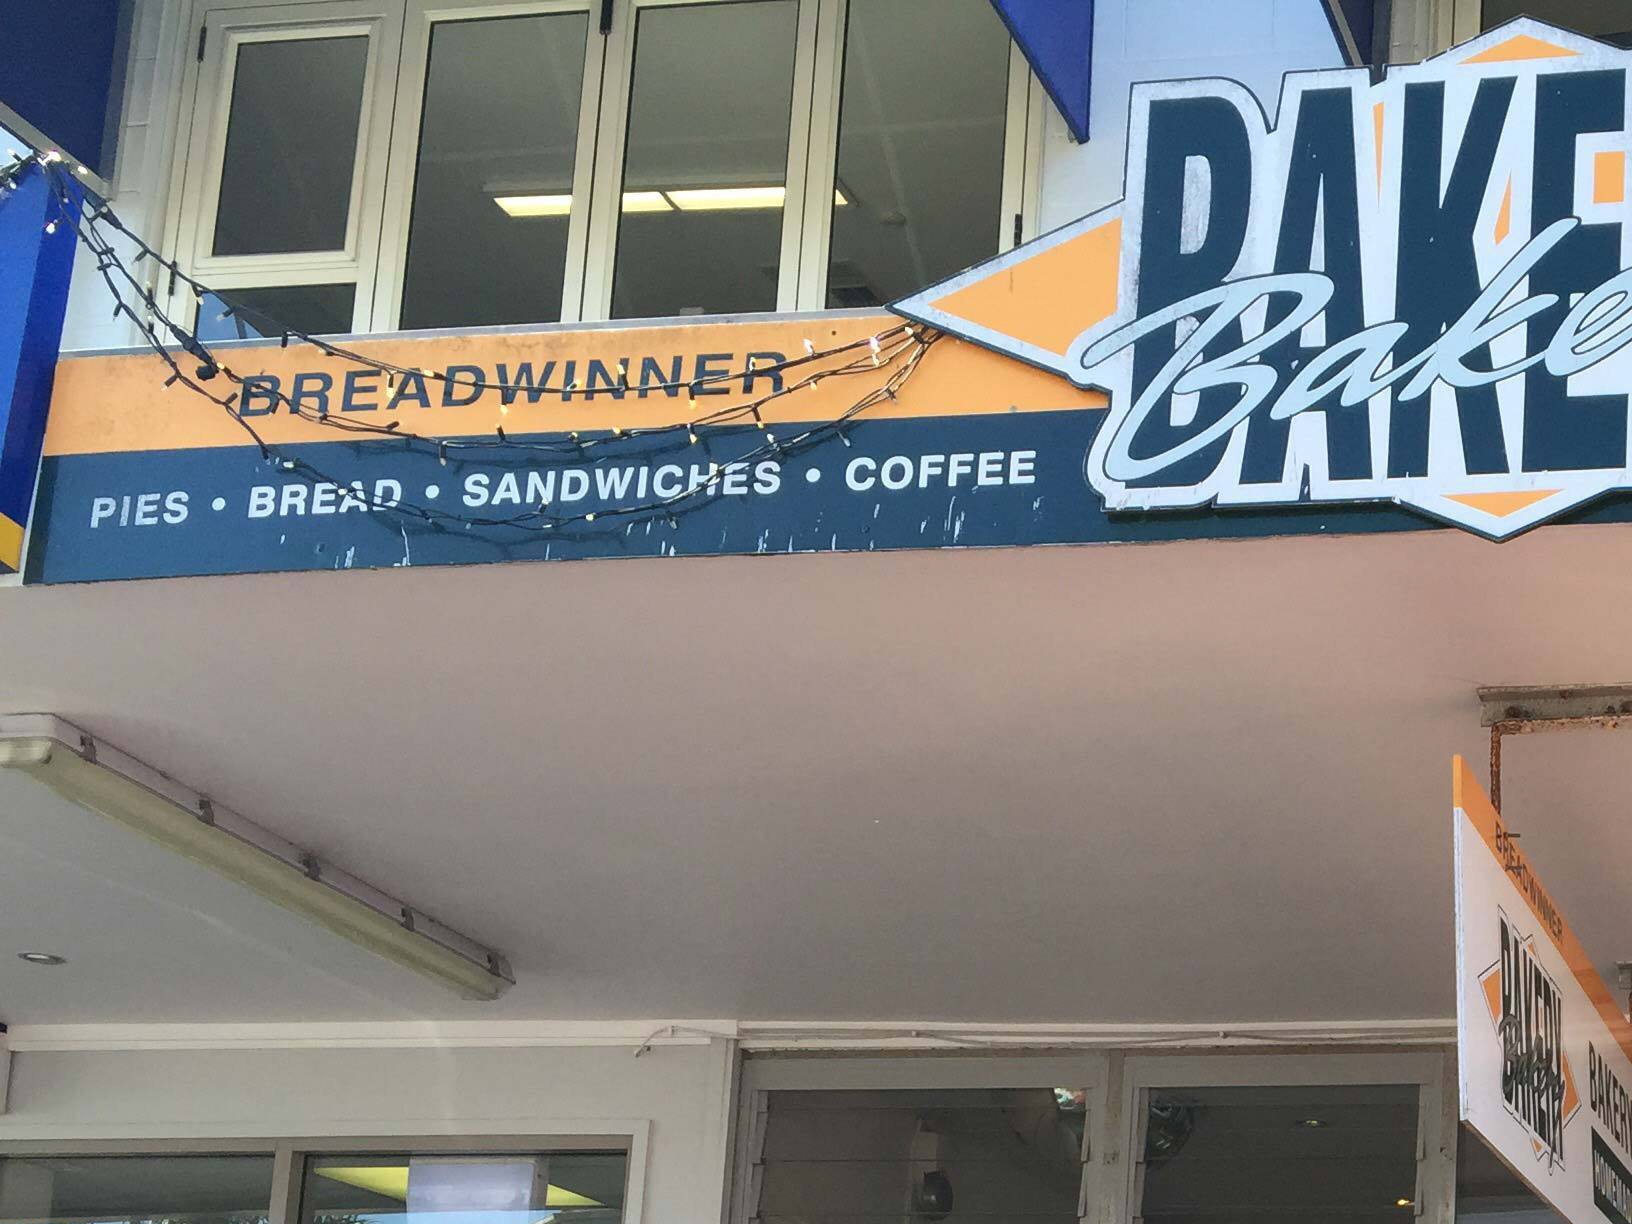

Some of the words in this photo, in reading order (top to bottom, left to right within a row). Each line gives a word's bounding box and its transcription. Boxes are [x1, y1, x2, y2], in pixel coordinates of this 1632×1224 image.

[239, 351, 787, 418] BREADWINNER
[90, 489, 189, 531] PIES
[247, 477, 402, 520] BREAD
[461, 459, 783, 509] SANDWICHES
[844, 449, 1036, 493] COFFEE
